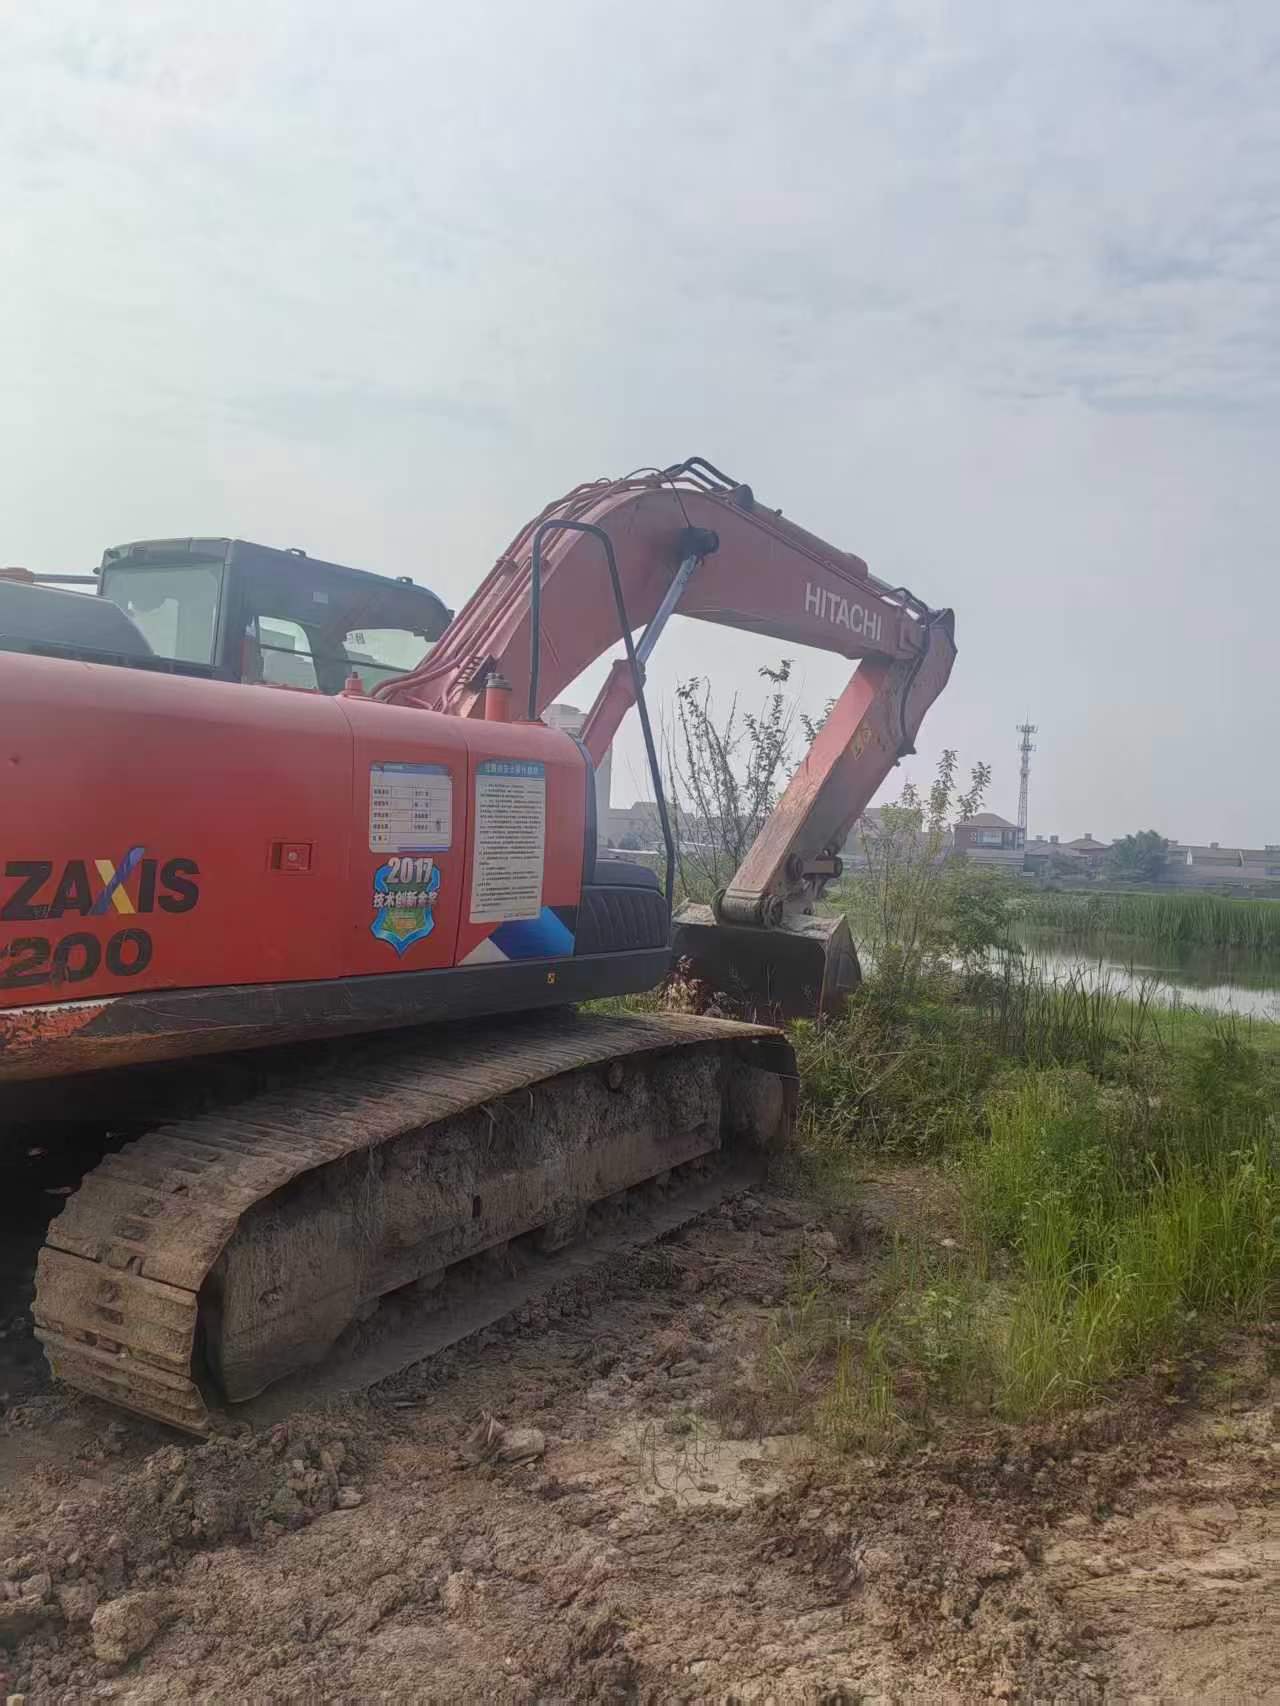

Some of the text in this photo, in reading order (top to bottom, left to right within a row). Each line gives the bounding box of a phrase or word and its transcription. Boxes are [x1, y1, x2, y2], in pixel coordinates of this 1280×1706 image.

[805, 583, 882, 640] HITACHI
[1, 846, 200, 921] ZAXIS
[387, 857, 433, 883] 2017
[0, 928, 153, 988] 200
